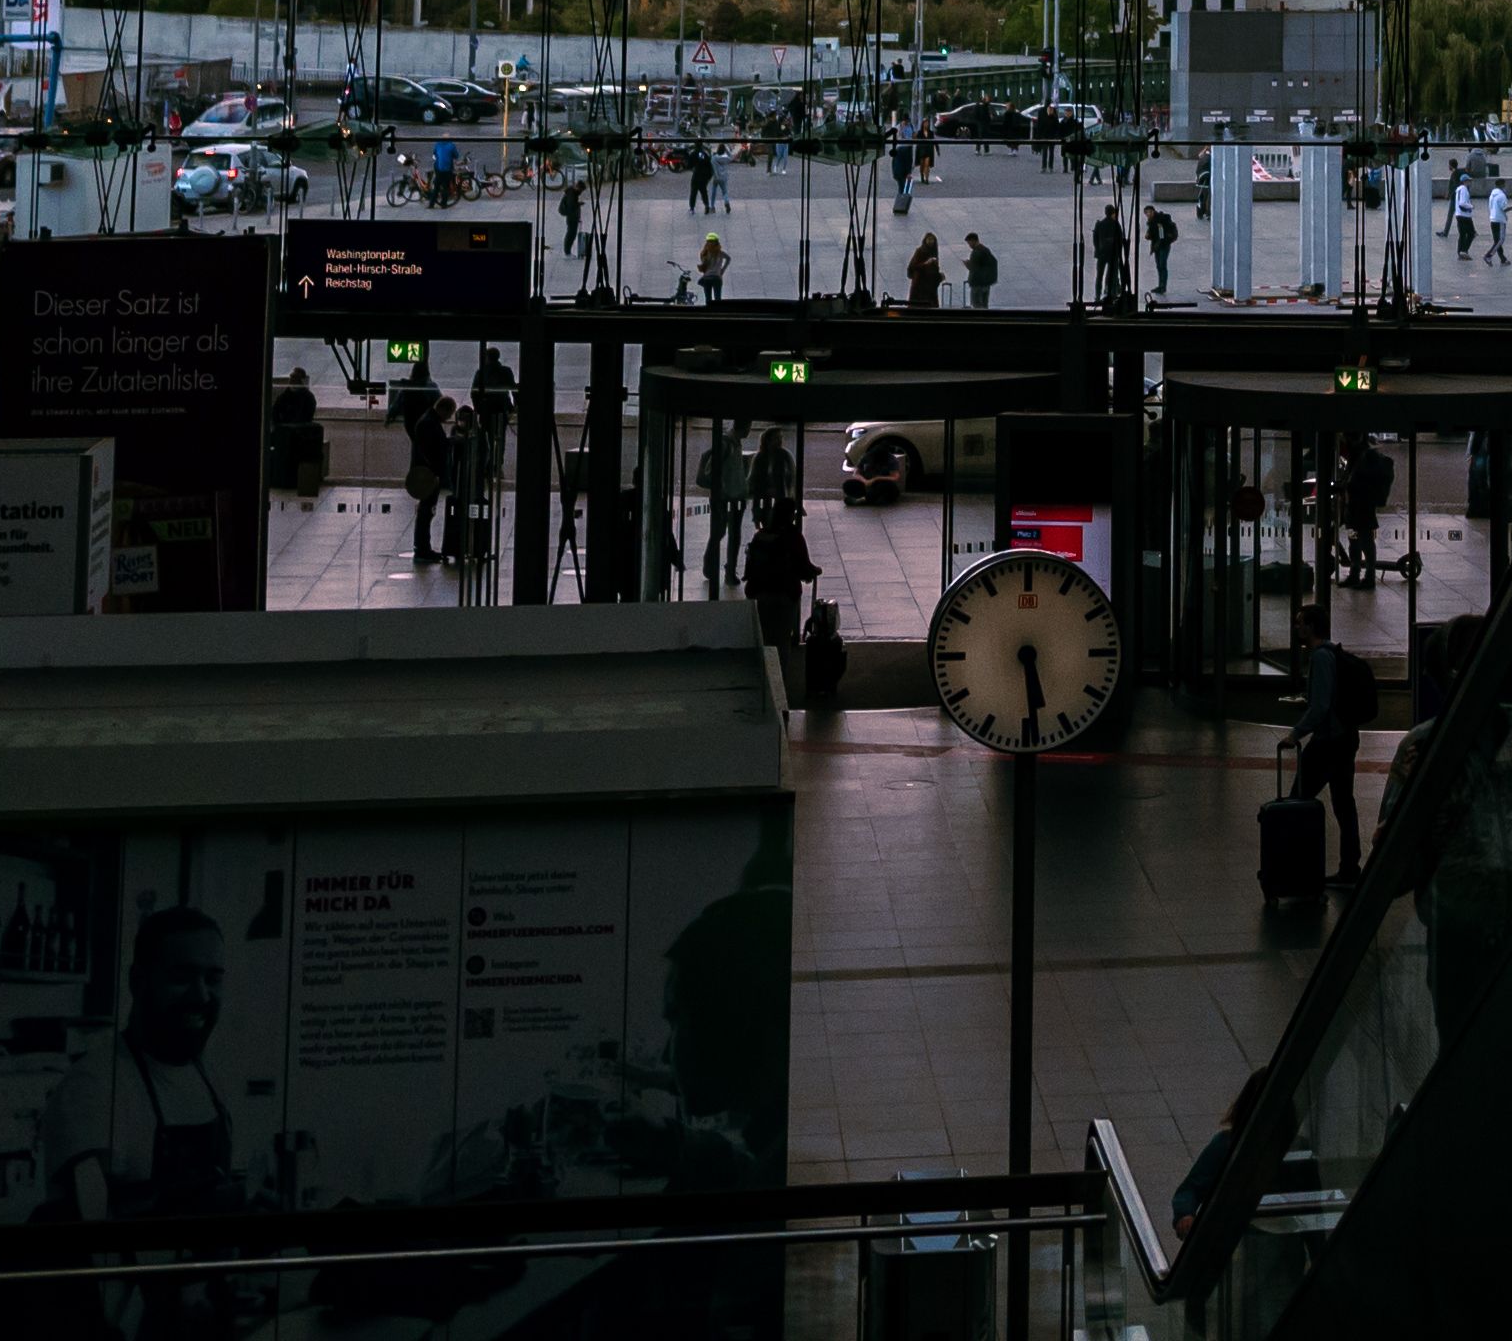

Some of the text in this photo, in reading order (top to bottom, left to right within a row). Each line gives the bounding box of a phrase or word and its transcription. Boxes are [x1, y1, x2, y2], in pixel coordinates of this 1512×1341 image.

[326, 248, 406, 262] Washingtonplatz
[325, 263, 423, 276] Rahel-Hirsch-Straße
[325, 277, 372, 292] Reichstag
[33, 288, 200, 317] Dieser Satz ist
[31, 322, 231, 362] schon länger als
[31, 363, 219, 394] ihre Zutatenliste.
[10, 529, 28, 540] für
[168, 520, 207, 537] NEU
[115, 571, 154, 585] SPORT
[1020, 595, 1037, 608] DB
[306, 870, 415, 892] IMMER FÜR
[305, 894, 392, 913] MICH DA
